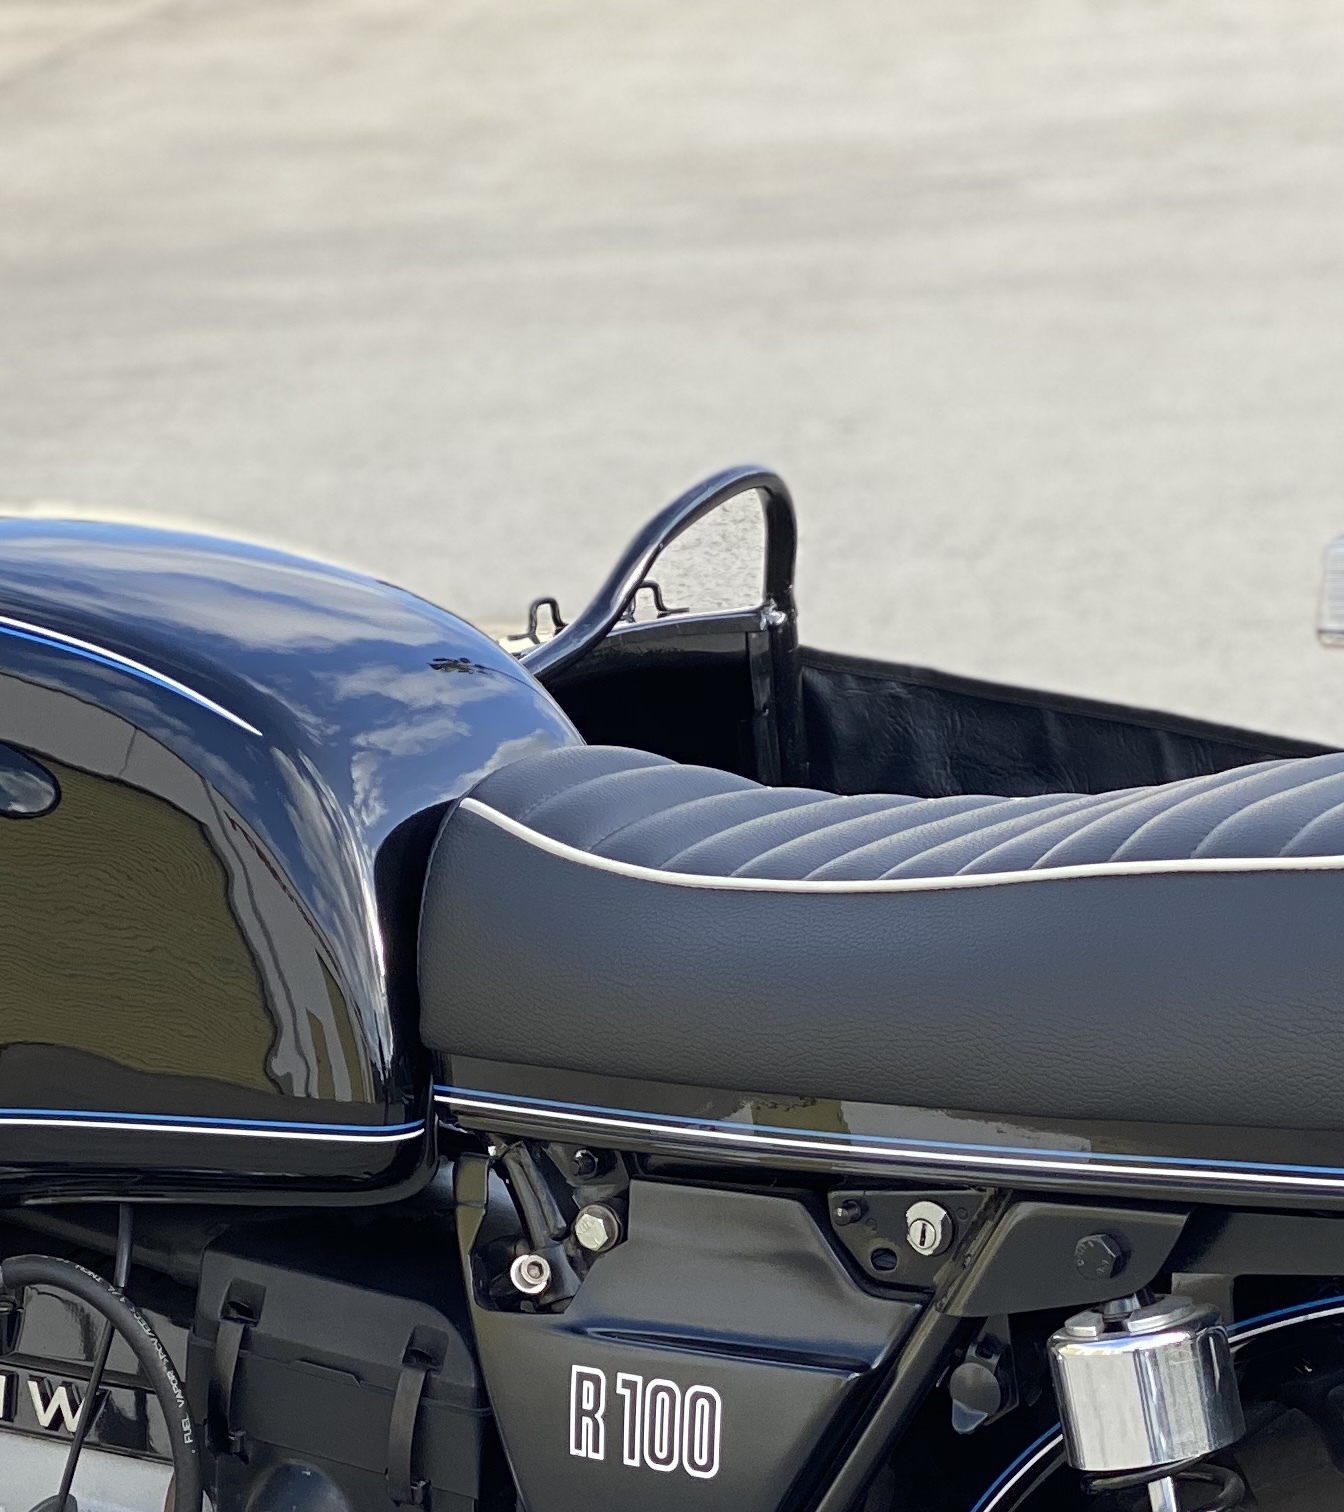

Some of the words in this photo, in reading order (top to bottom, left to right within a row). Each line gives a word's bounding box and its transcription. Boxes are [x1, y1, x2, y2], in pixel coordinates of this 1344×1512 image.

[166, 1370, 185, 1408] VAPOR
[181, 1412, 194, 1445] FUEL
[569, 1364, 606, 1461] R
[615, 1371, 722, 1479] 100
